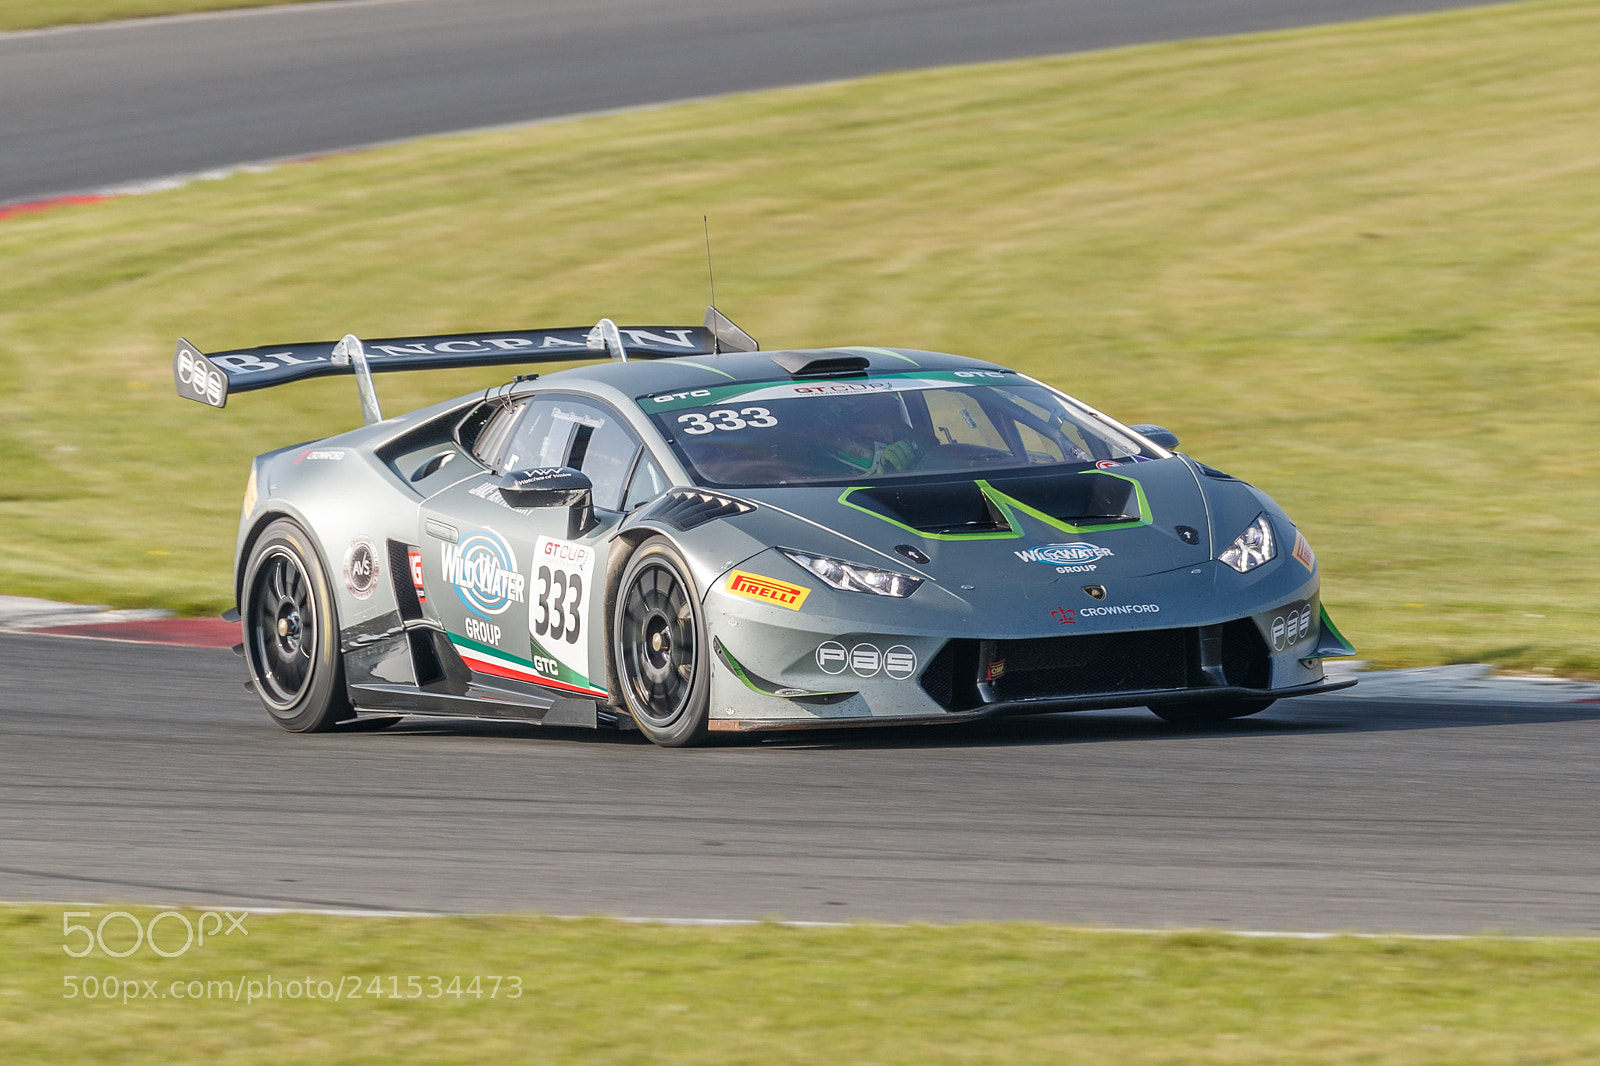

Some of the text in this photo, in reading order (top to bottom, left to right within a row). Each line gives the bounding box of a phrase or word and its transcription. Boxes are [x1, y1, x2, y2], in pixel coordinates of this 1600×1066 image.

[210, 330, 696, 375] BLNCPAN
[653, 389, 711, 403] GTC
[794, 386, 825, 394] GT
[677, 407, 778, 435] 333
[544, 541, 560, 557] GT
[560, 545, 586, 562] CUP
[352, 551, 371, 576] AVS
[1055, 564, 1098, 575] GROUP
[730, 574, 802, 605] PIRELLI
[535, 565, 583, 645] 333
[1079, 603, 1161, 618] CROWNFORD
[464, 617, 502, 646] GROUP
[533, 655, 559, 676] GTC
